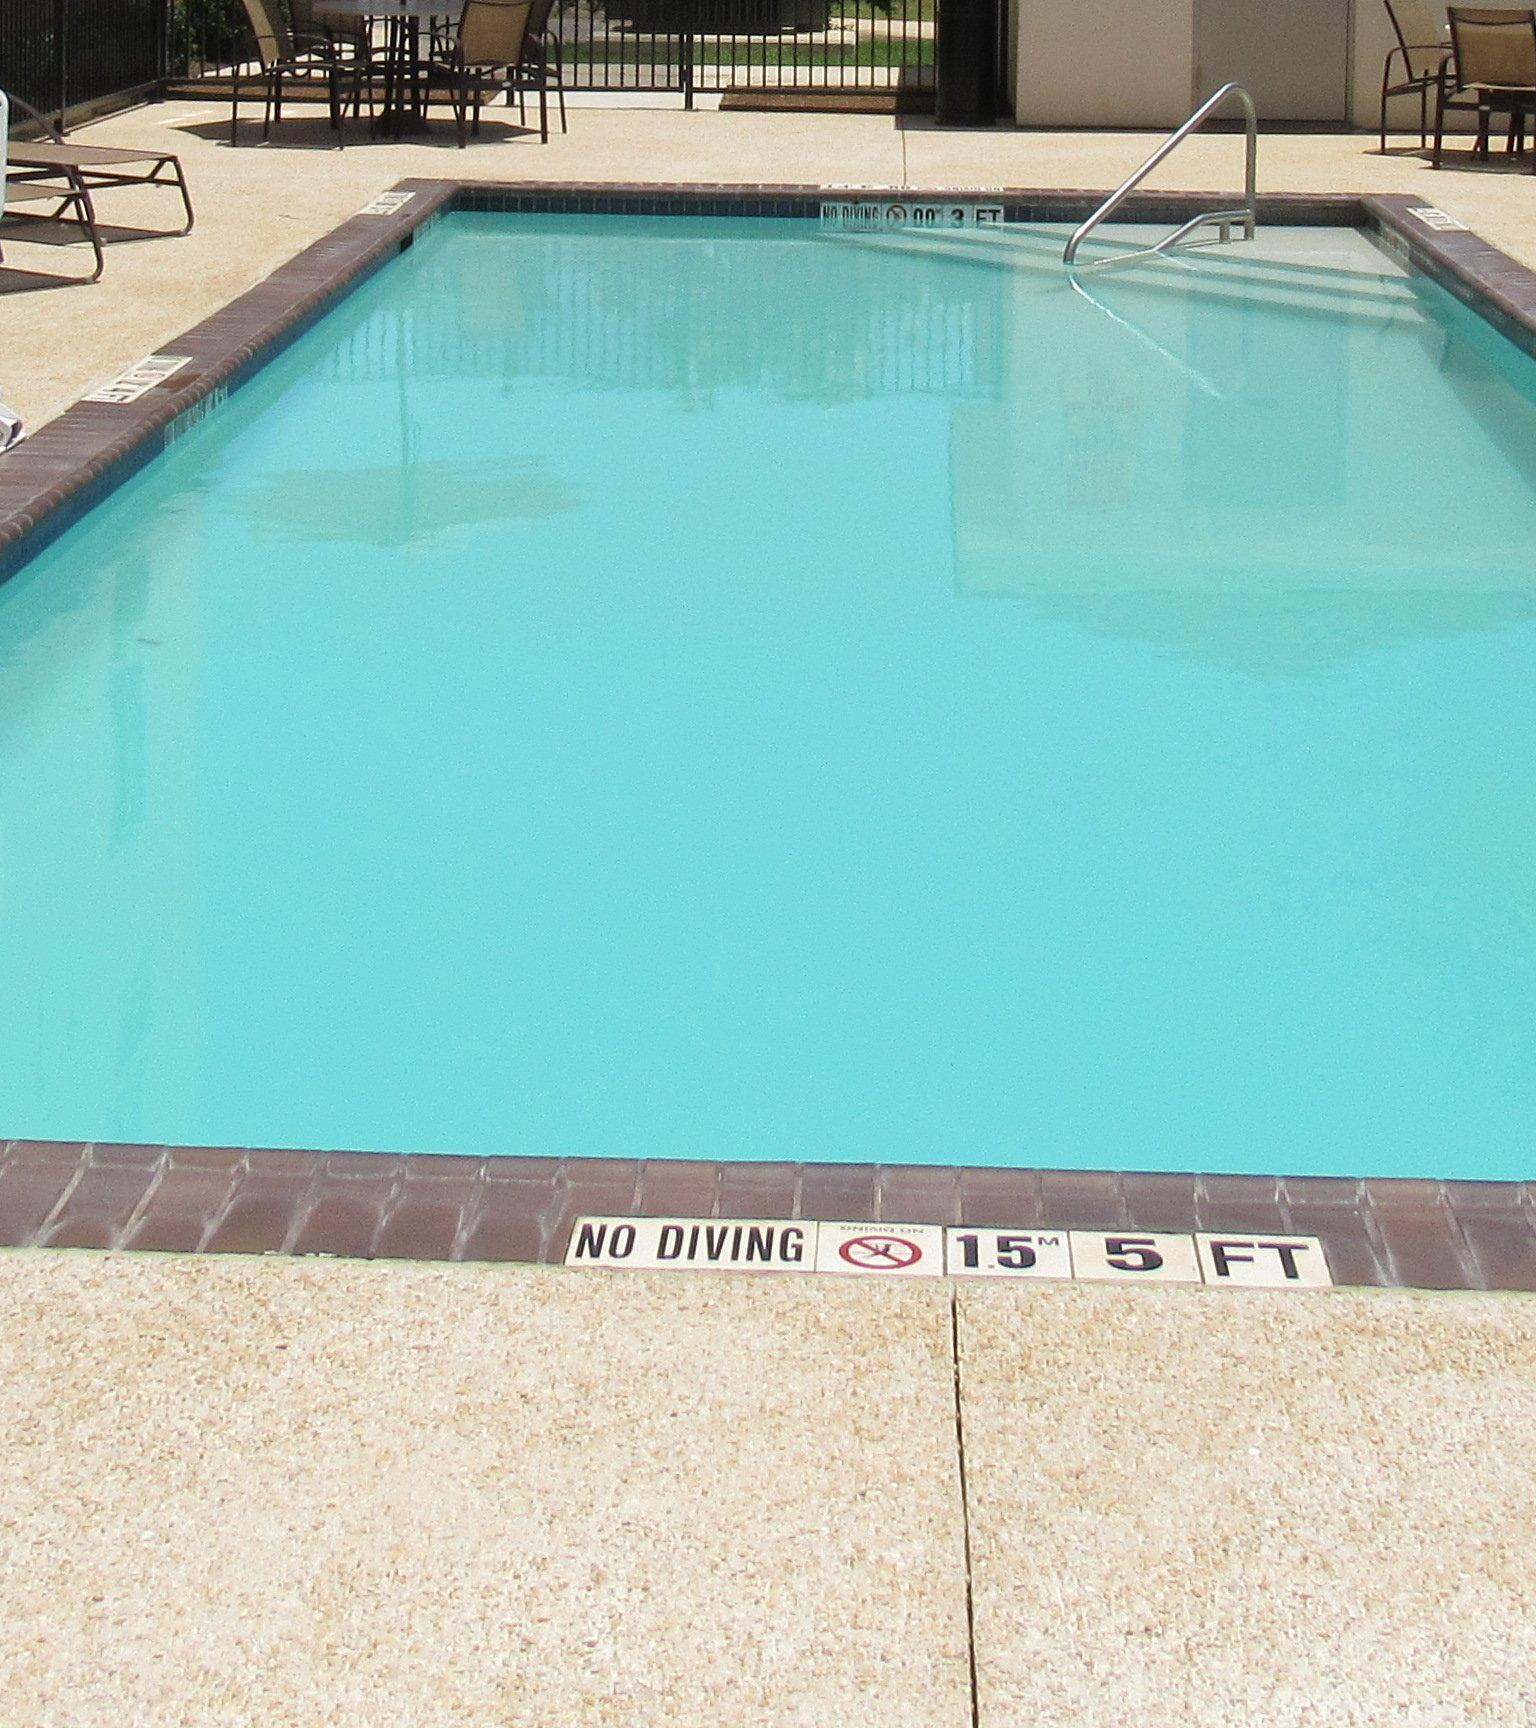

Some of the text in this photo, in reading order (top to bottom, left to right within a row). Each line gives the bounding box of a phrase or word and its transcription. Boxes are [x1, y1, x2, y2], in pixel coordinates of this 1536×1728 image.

[574, 1223, 637, 1260] NO
[655, 1224, 805, 1263] DIVING
[1104, 1236, 1164, 1272] 5
[1209, 1240, 1310, 1279] FT
